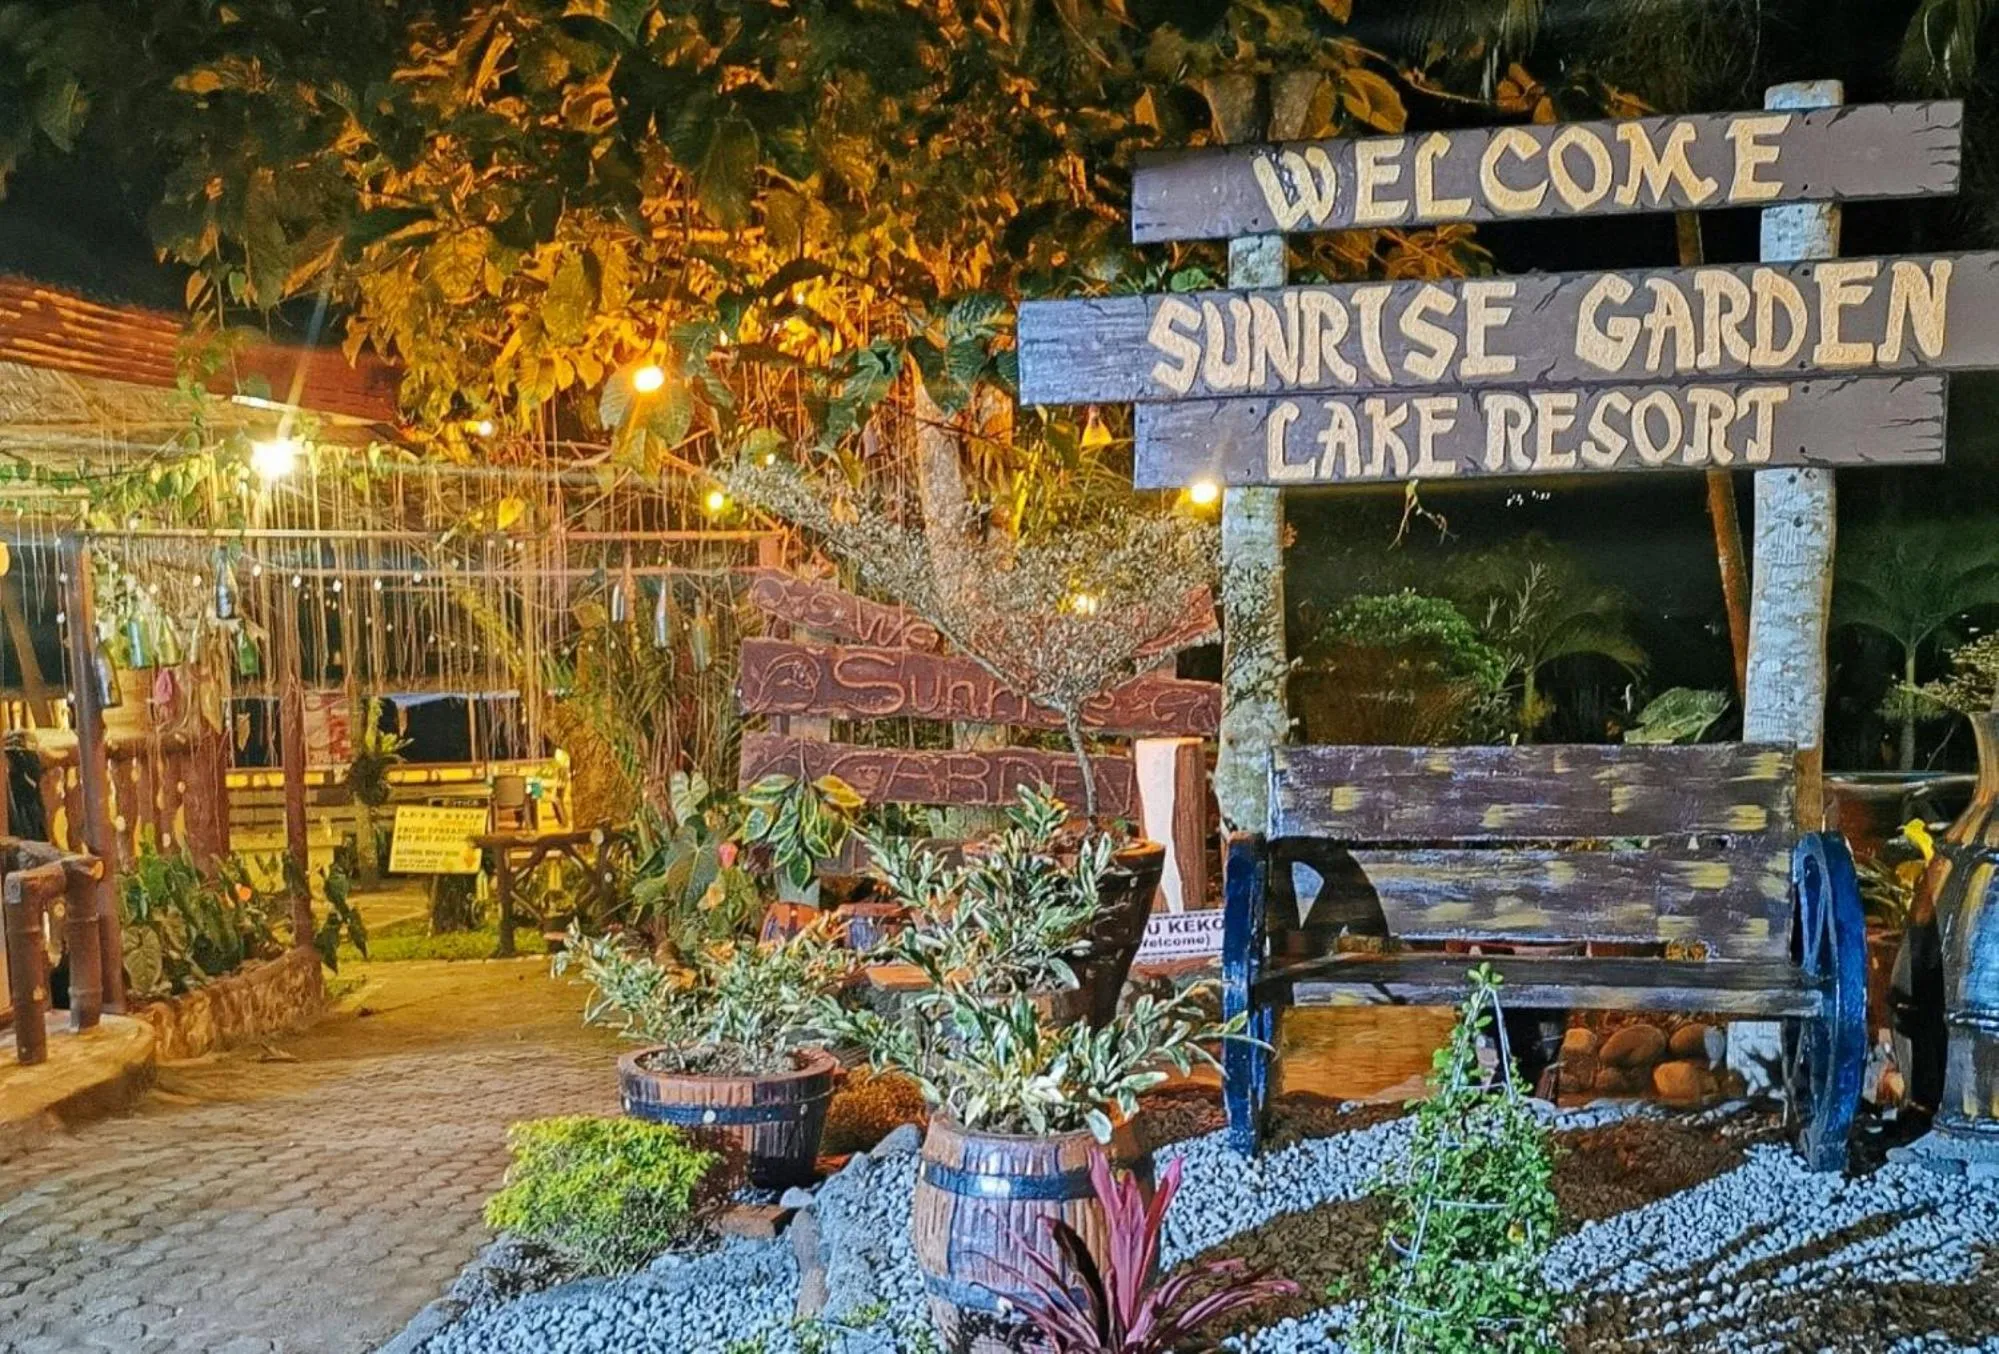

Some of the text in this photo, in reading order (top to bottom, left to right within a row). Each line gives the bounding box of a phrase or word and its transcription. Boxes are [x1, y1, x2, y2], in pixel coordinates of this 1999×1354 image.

[1253, 114, 1792, 231] WELCOME
[1148, 258, 1953, 395] SUNRISE GARDEN
[1267, 384, 1791, 480] LAKE RESORT
